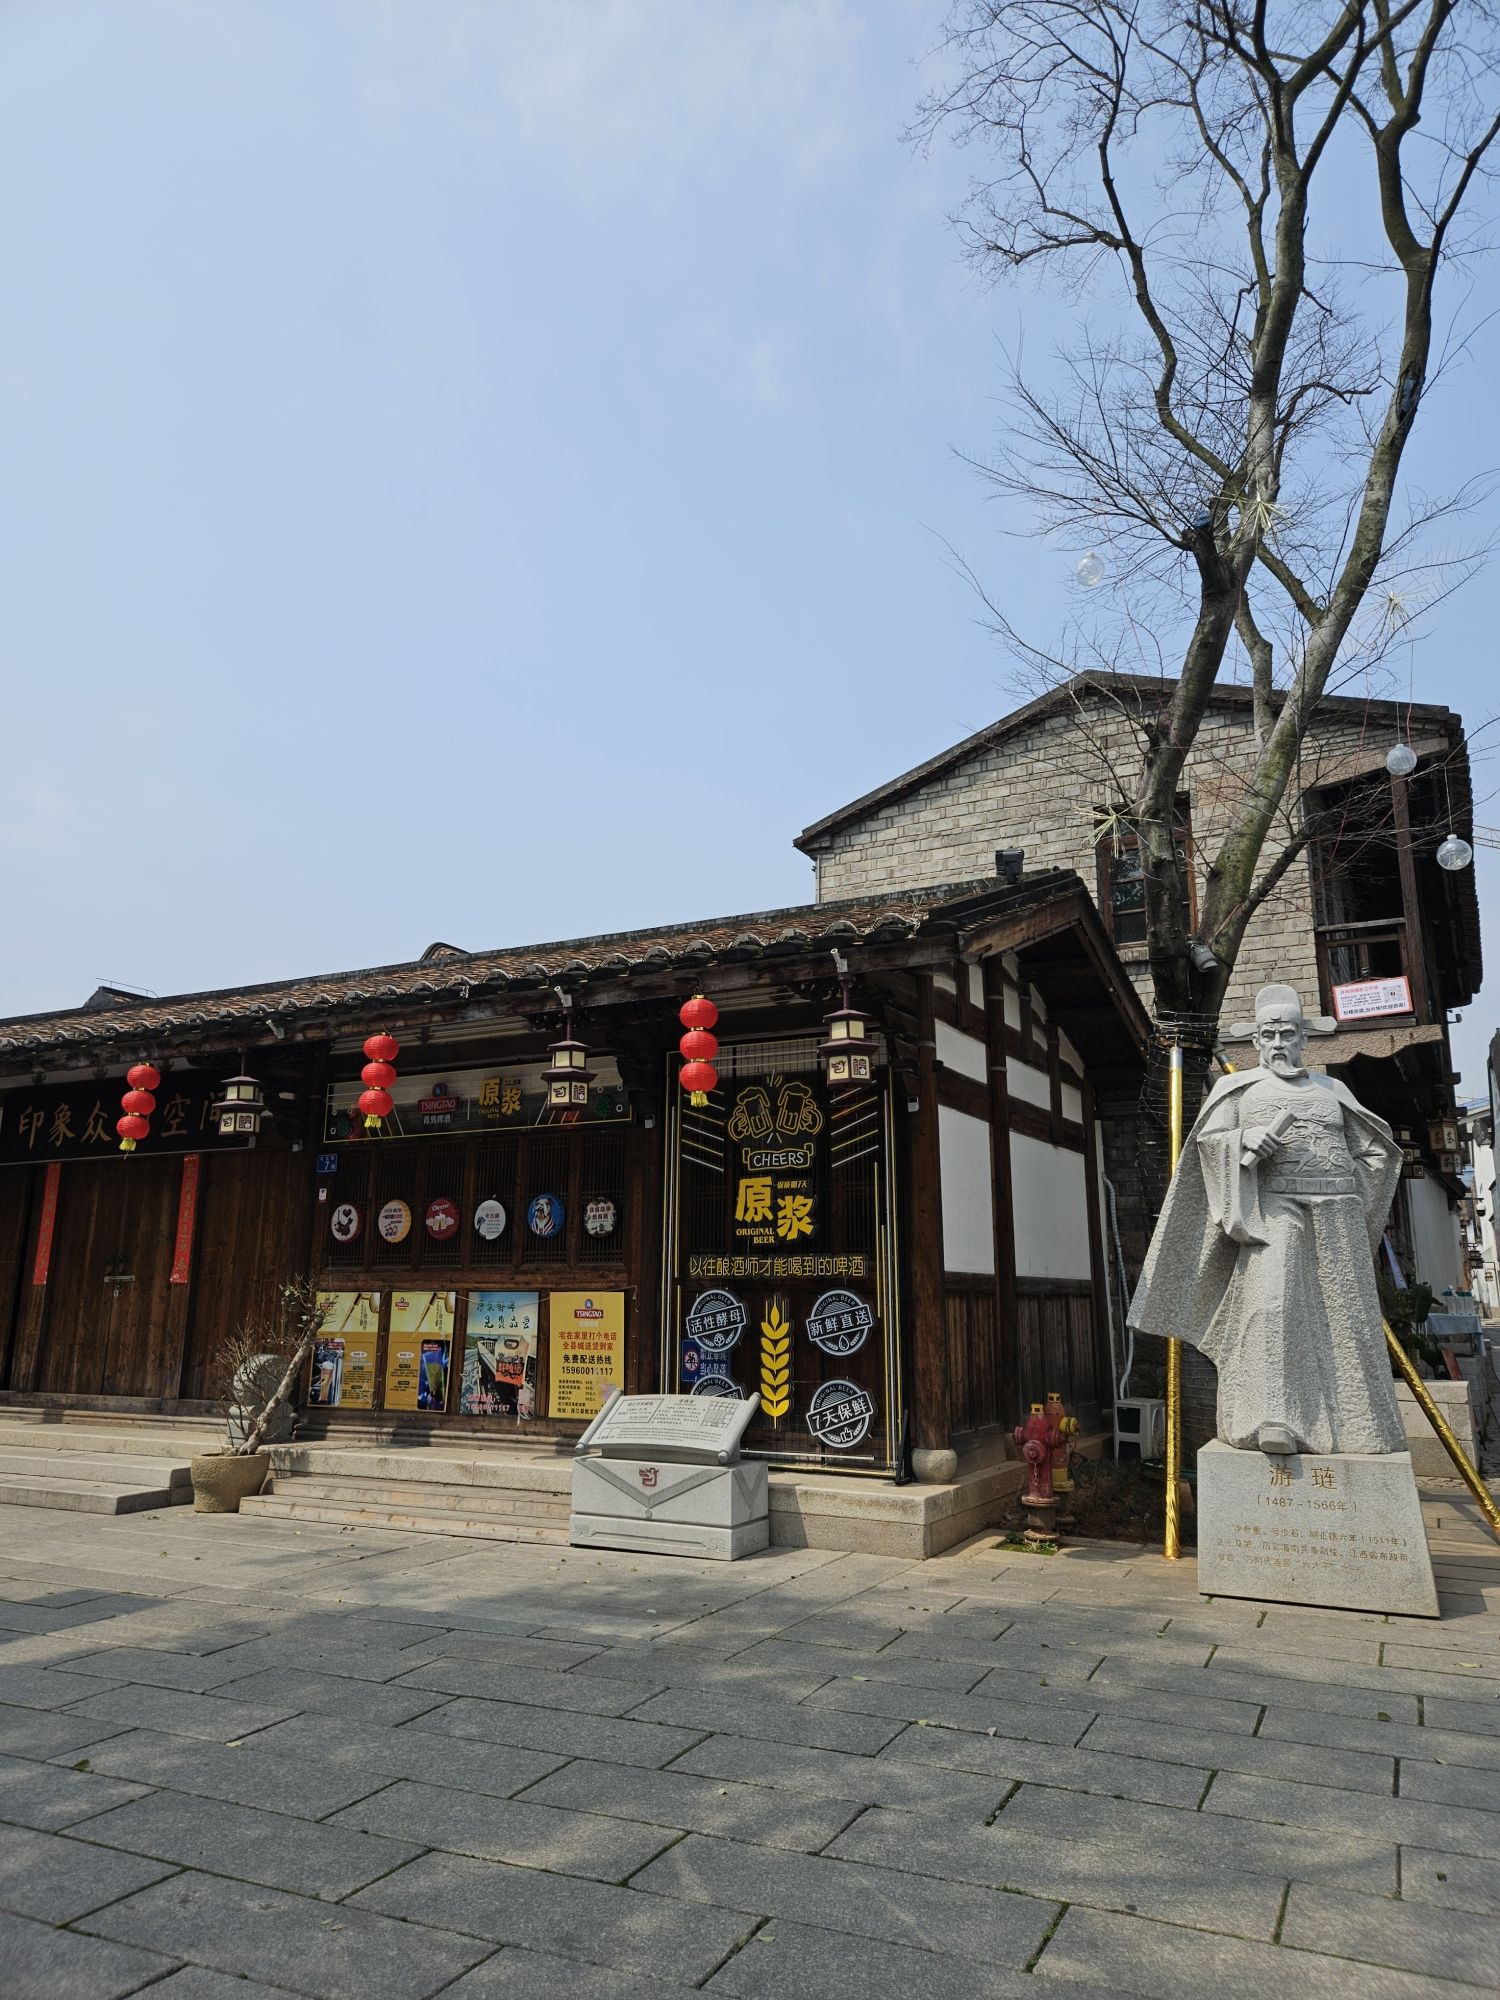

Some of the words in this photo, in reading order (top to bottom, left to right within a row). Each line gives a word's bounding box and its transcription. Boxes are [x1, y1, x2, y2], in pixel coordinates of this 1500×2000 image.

[419, 1099, 457, 1112] TSINGTAO
[479, 1077, 523, 1116] 原浆
[18, 1090, 227, 1150] 印象众空间
[753, 1151, 805, 1167] CHEERS
[735, 1176, 814, 1241] 原浆
[736, 1228, 774, 1236] ORIGINAL
[753, 1235, 775, 1244] BEER
[690, 1256, 865, 1276] 以往酿酒师才能喝到的啤酒
[695, 1294, 717, 1314] ORIGINAL
[716, 1294, 732, 1305] BEER
[815, 1294, 839, 1315] ORIGINAL
[839, 1294, 857, 1306] BEER
[576, 1310, 602, 1318] TSINGTAO
[690, 1308, 742, 1333] 活性酵母
[809, 1310, 870, 1337] 新鲜直送
[558, 1332, 617, 1341] 宅在家里打个电话
[562, 1341, 614, 1351] 全县城送货到家
[563, 1354, 612, 1365] 免费配送热线
[561, 1366, 614, 1376] 1596001117
[694, 1381, 717, 1396] RIGINAL
[815, 1386, 838, 1408] ORIGINAL
[837, 1385, 854, 1395] BEER
[811, 1399, 868, 1430] 7天保鲜
